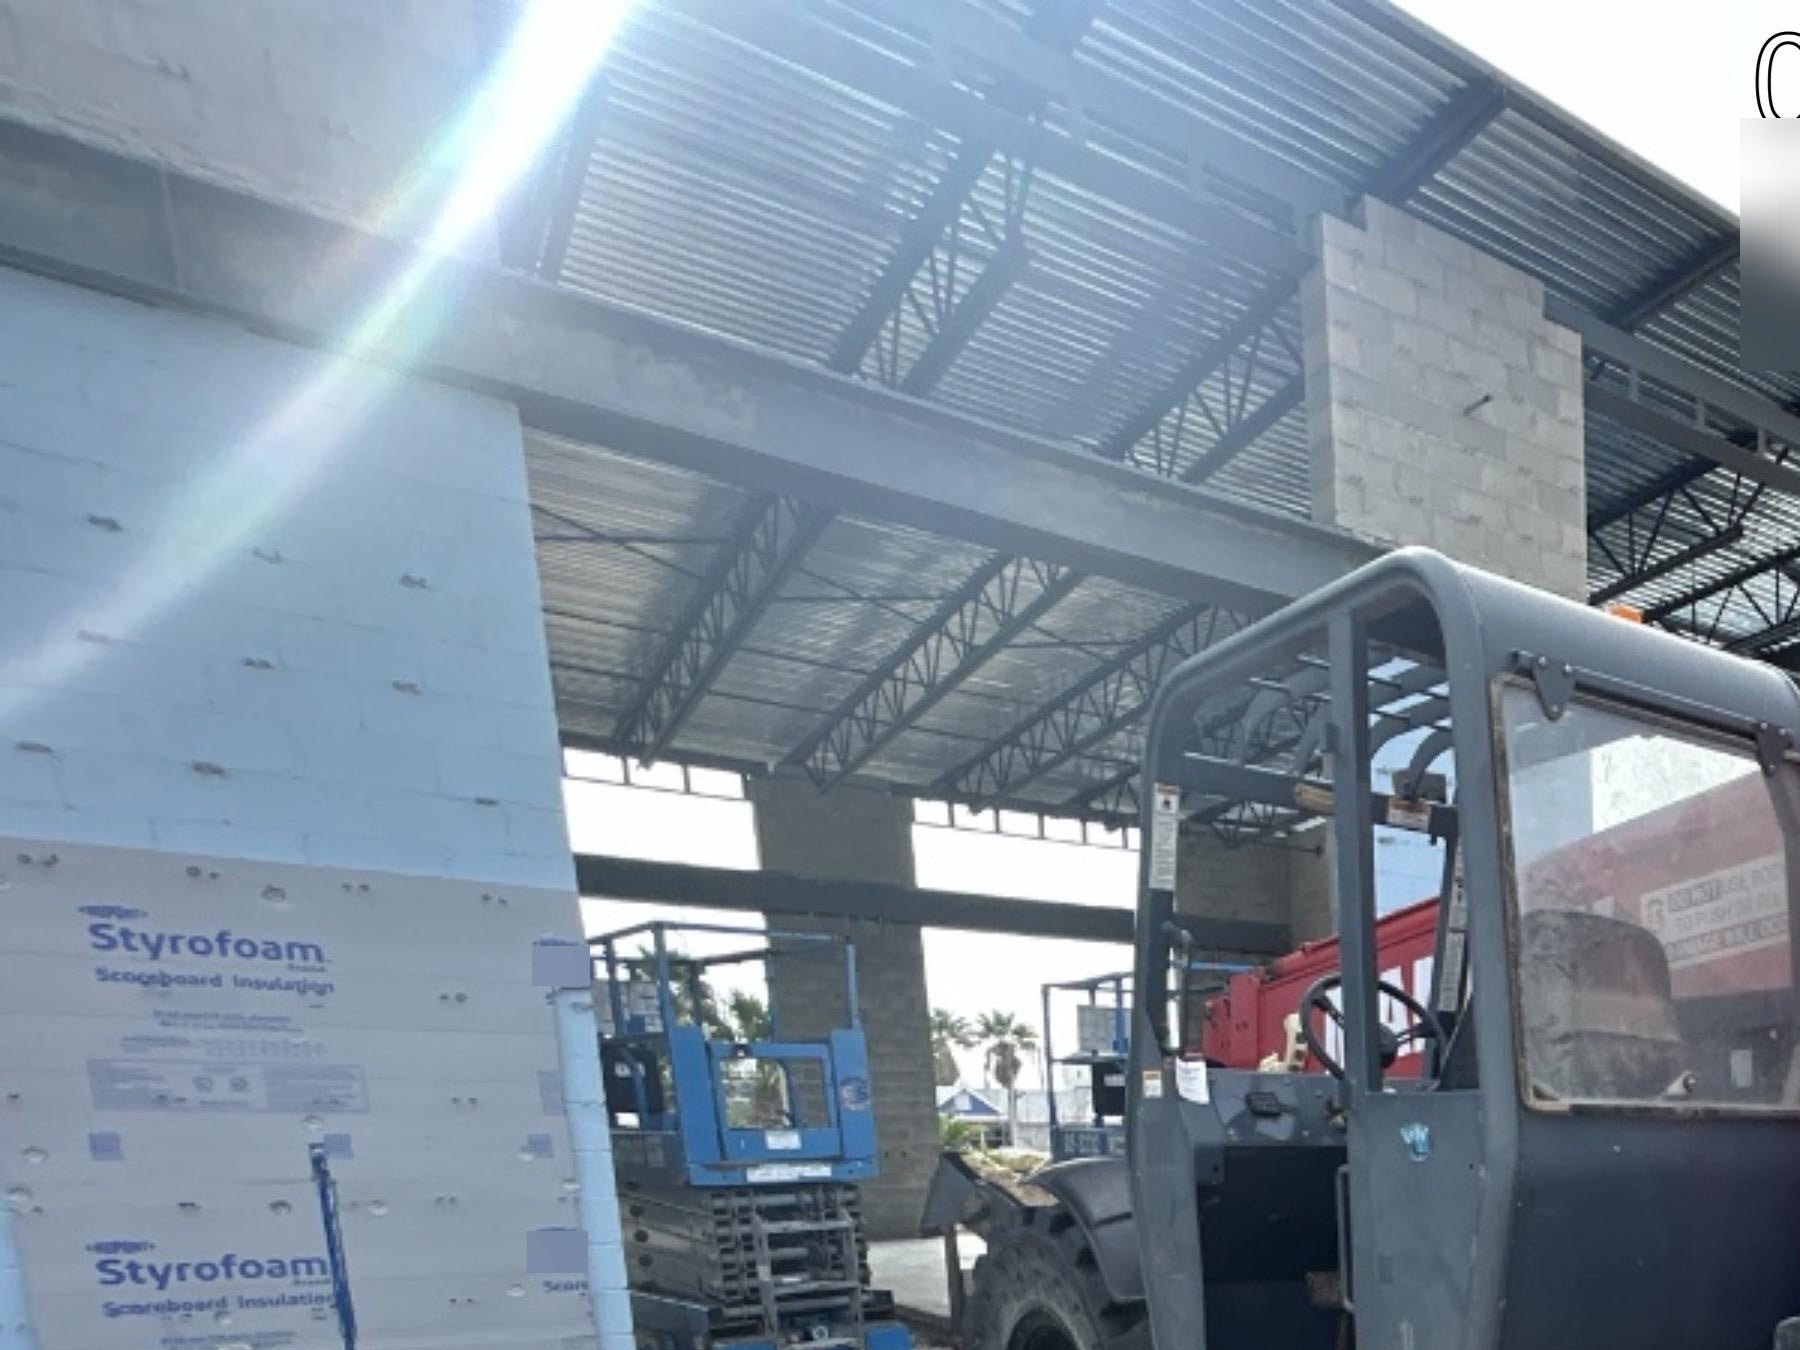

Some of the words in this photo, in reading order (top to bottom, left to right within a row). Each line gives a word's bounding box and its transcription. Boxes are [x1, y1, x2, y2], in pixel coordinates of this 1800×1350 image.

[88, 922, 325, 962] Styrofoam
[95, 967, 223, 988] Scoreboard
[233, 974, 335, 995] Insulation
[96, 1254, 329, 1291] Styrofoam
[103, 1295, 228, 1317] Scoreboard
